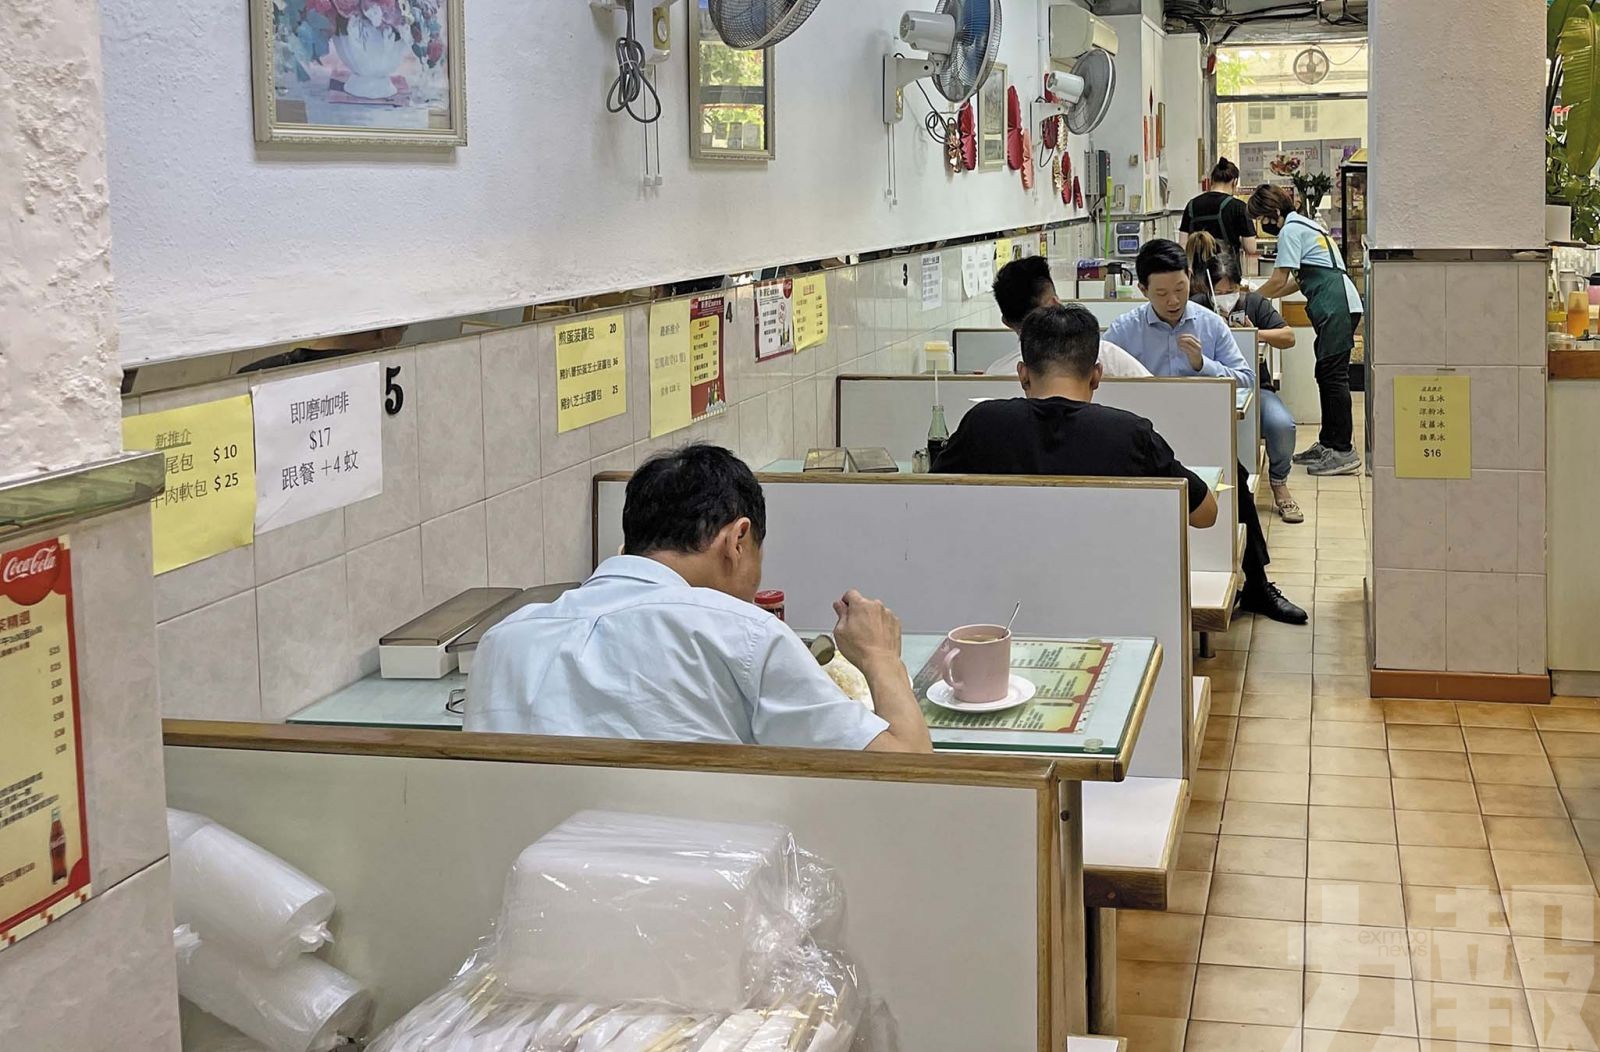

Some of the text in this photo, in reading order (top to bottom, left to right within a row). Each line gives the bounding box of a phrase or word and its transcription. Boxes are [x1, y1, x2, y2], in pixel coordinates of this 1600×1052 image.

[902, 263, 908, 286] 3
[725, 301, 733, 323] 4
[608, 323, 617, 334] 20
[385, 366, 403, 416] 5
[290, 391, 349, 424] 即磨咖啡
[156, 429, 192, 447] 新推介
[309, 427, 331, 450] $17
[224, 444, 238, 459] 10
[1423, 448, 1442, 458] $16
[225, 472, 239, 488] 25
[282, 461, 315, 491] 跟餐
[344, 450, 359, 473] 蚊
